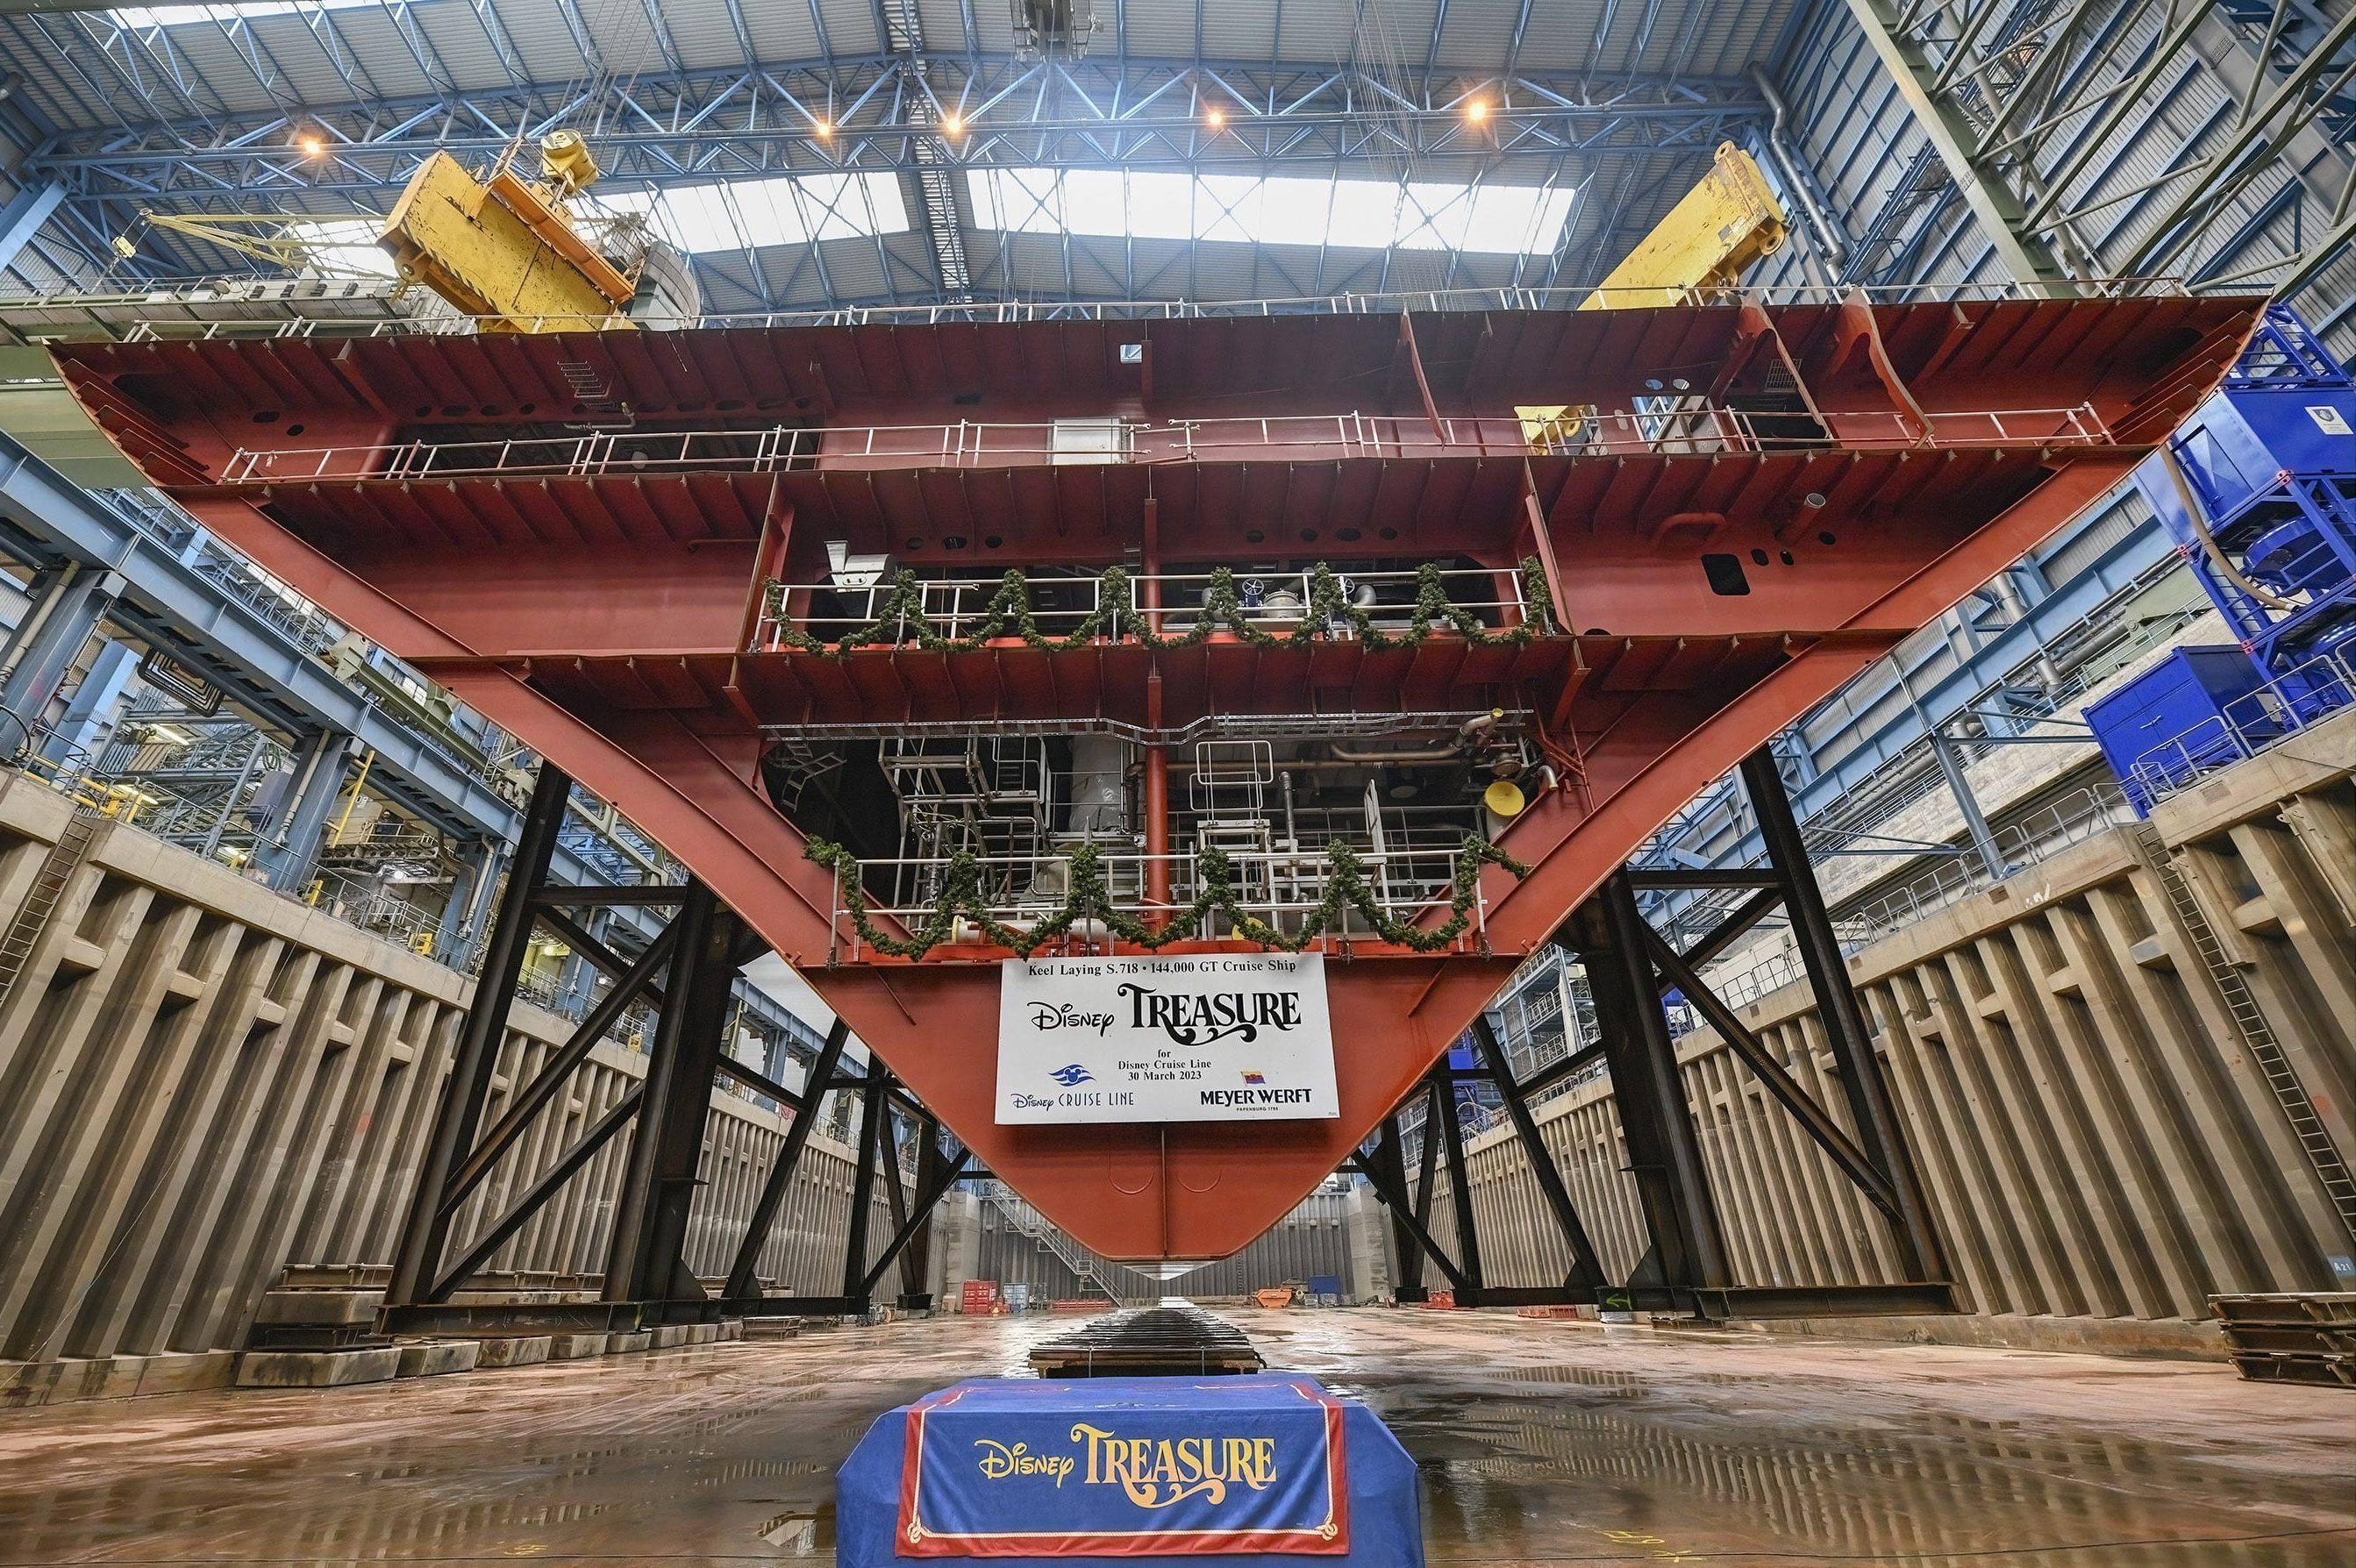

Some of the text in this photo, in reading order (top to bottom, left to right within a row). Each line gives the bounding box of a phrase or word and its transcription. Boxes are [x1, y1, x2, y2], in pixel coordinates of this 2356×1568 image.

[1029, 959, 1296, 977] Keel Laying S.718 144,000 GT Cruise Ship
[1117, 982, 1302, 1046] TREASURE
[1157, 1049, 1171, 1058] for
[1118, 1058, 1212, 1071] Disney Cruise Line
[1128, 1070, 1202, 1081] 30 March 2023
[1058, 1093, 1101, 1107] CRUISE
[1109, 1092, 1134, 1106] LINE
[1200, 1088, 1312, 1107] MEYER WERFT
[1070, 1422, 1277, 1508] TREASURE
